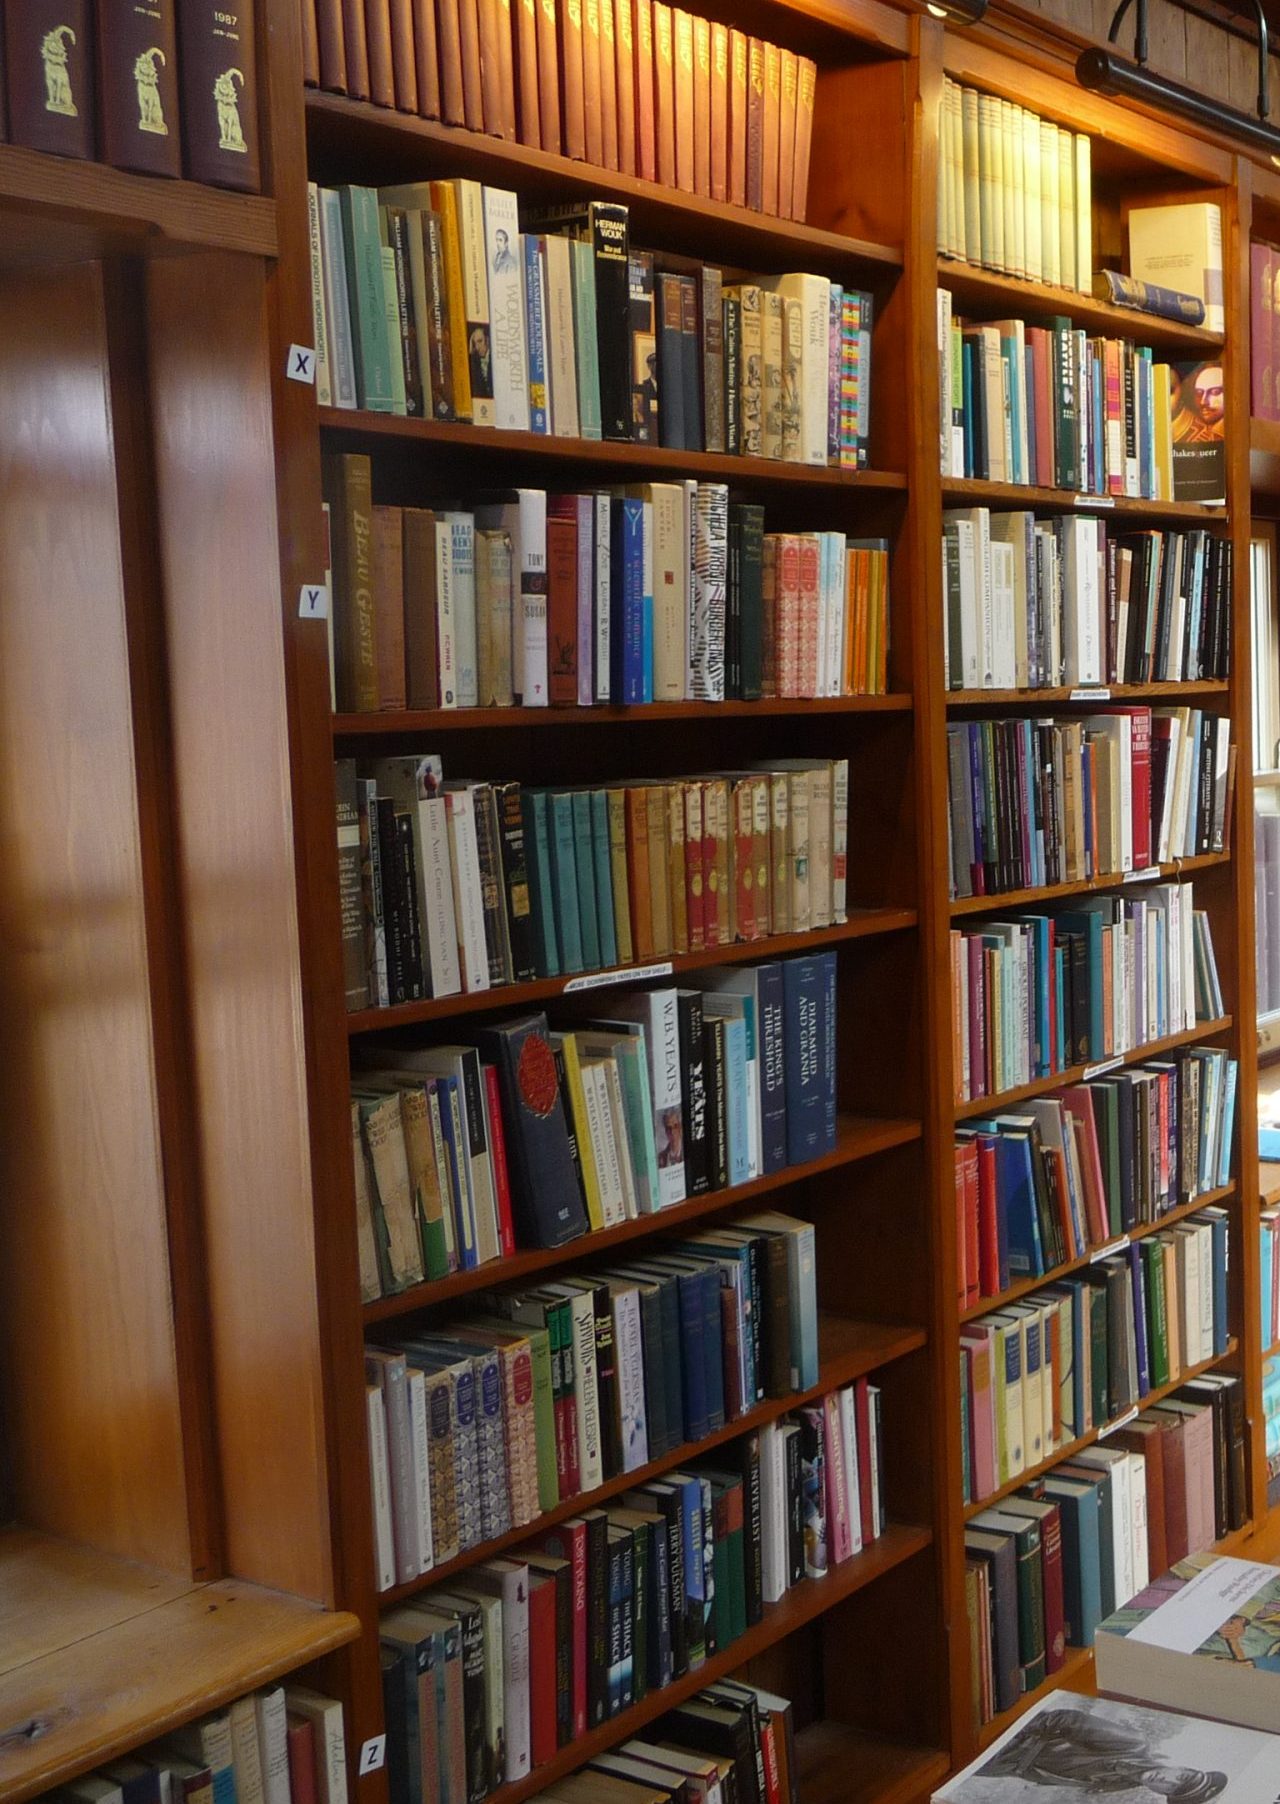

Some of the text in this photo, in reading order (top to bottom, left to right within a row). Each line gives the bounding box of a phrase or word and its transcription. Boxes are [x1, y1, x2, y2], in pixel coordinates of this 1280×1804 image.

[213, 11, 238, 25] 1987
[428, 220, 436, 252] WILLIAM
[595, 219, 626, 233] HERMAN
[600, 228, 623, 240] WOUK
[309, 192, 325, 363] JOURNALS OF DOROTHY WORDSWORTH
[394, 217, 409, 336] WILLIAM WORDSWORTH LETTERS
[431, 254, 441, 305] WORDSWORTH
[533, 265, 541, 312] GRASMERE
[495, 309, 508, 361] A LIFE
[506, 284, 524, 392] WORDSWORTH
[535, 313, 543, 373] JOURNALS
[728, 313, 736, 328] The
[809, 309, 818, 345] Wouk
[295, 352, 309, 375] X
[727, 356, 736, 387] Mutiny
[728, 389, 736, 423] Herman
[728, 425, 736, 449] Wouk
[528, 554, 544, 567] TONY
[709, 491, 727, 588] MICHELA WRONG
[308, 591, 320, 610] Y
[354, 510, 374, 667] BEAU GESTE
[442, 568, 450, 615] SABREUR
[634, 560, 643, 606] scientific
[432, 837, 441, 864] Aunt
[715, 1023, 723, 1061] ELLMANN
[763, 1004, 775, 1092] THRESHOLD
[774, 1006, 783, 1087] THE KING'S
[800, 996, 810, 1087] AND GRANIA
[808, 1002, 817, 1075] DIARMUID
[694, 1063, 706, 1140] YEATS
[630, 1308, 640, 1350] RAFAEL
[584, 1373, 596, 1405] HELEN
[585, 1408, 597, 1451] YGLESIAS
[751, 1469, 761, 1543] NEVER LIST
[576, 1534, 585, 1611] TOBY YOUNG
[624, 1549, 632, 1586] YOUNG
[669, 1524, 681, 1612] JERRY YULSMAN
[612, 1553, 621, 1663] YOUNG THE SHACK
[510, 1633, 521, 1684] CRADLE
[624, 1618, 632, 1658] SHACK
[368, 1745, 379, 1766] Z
